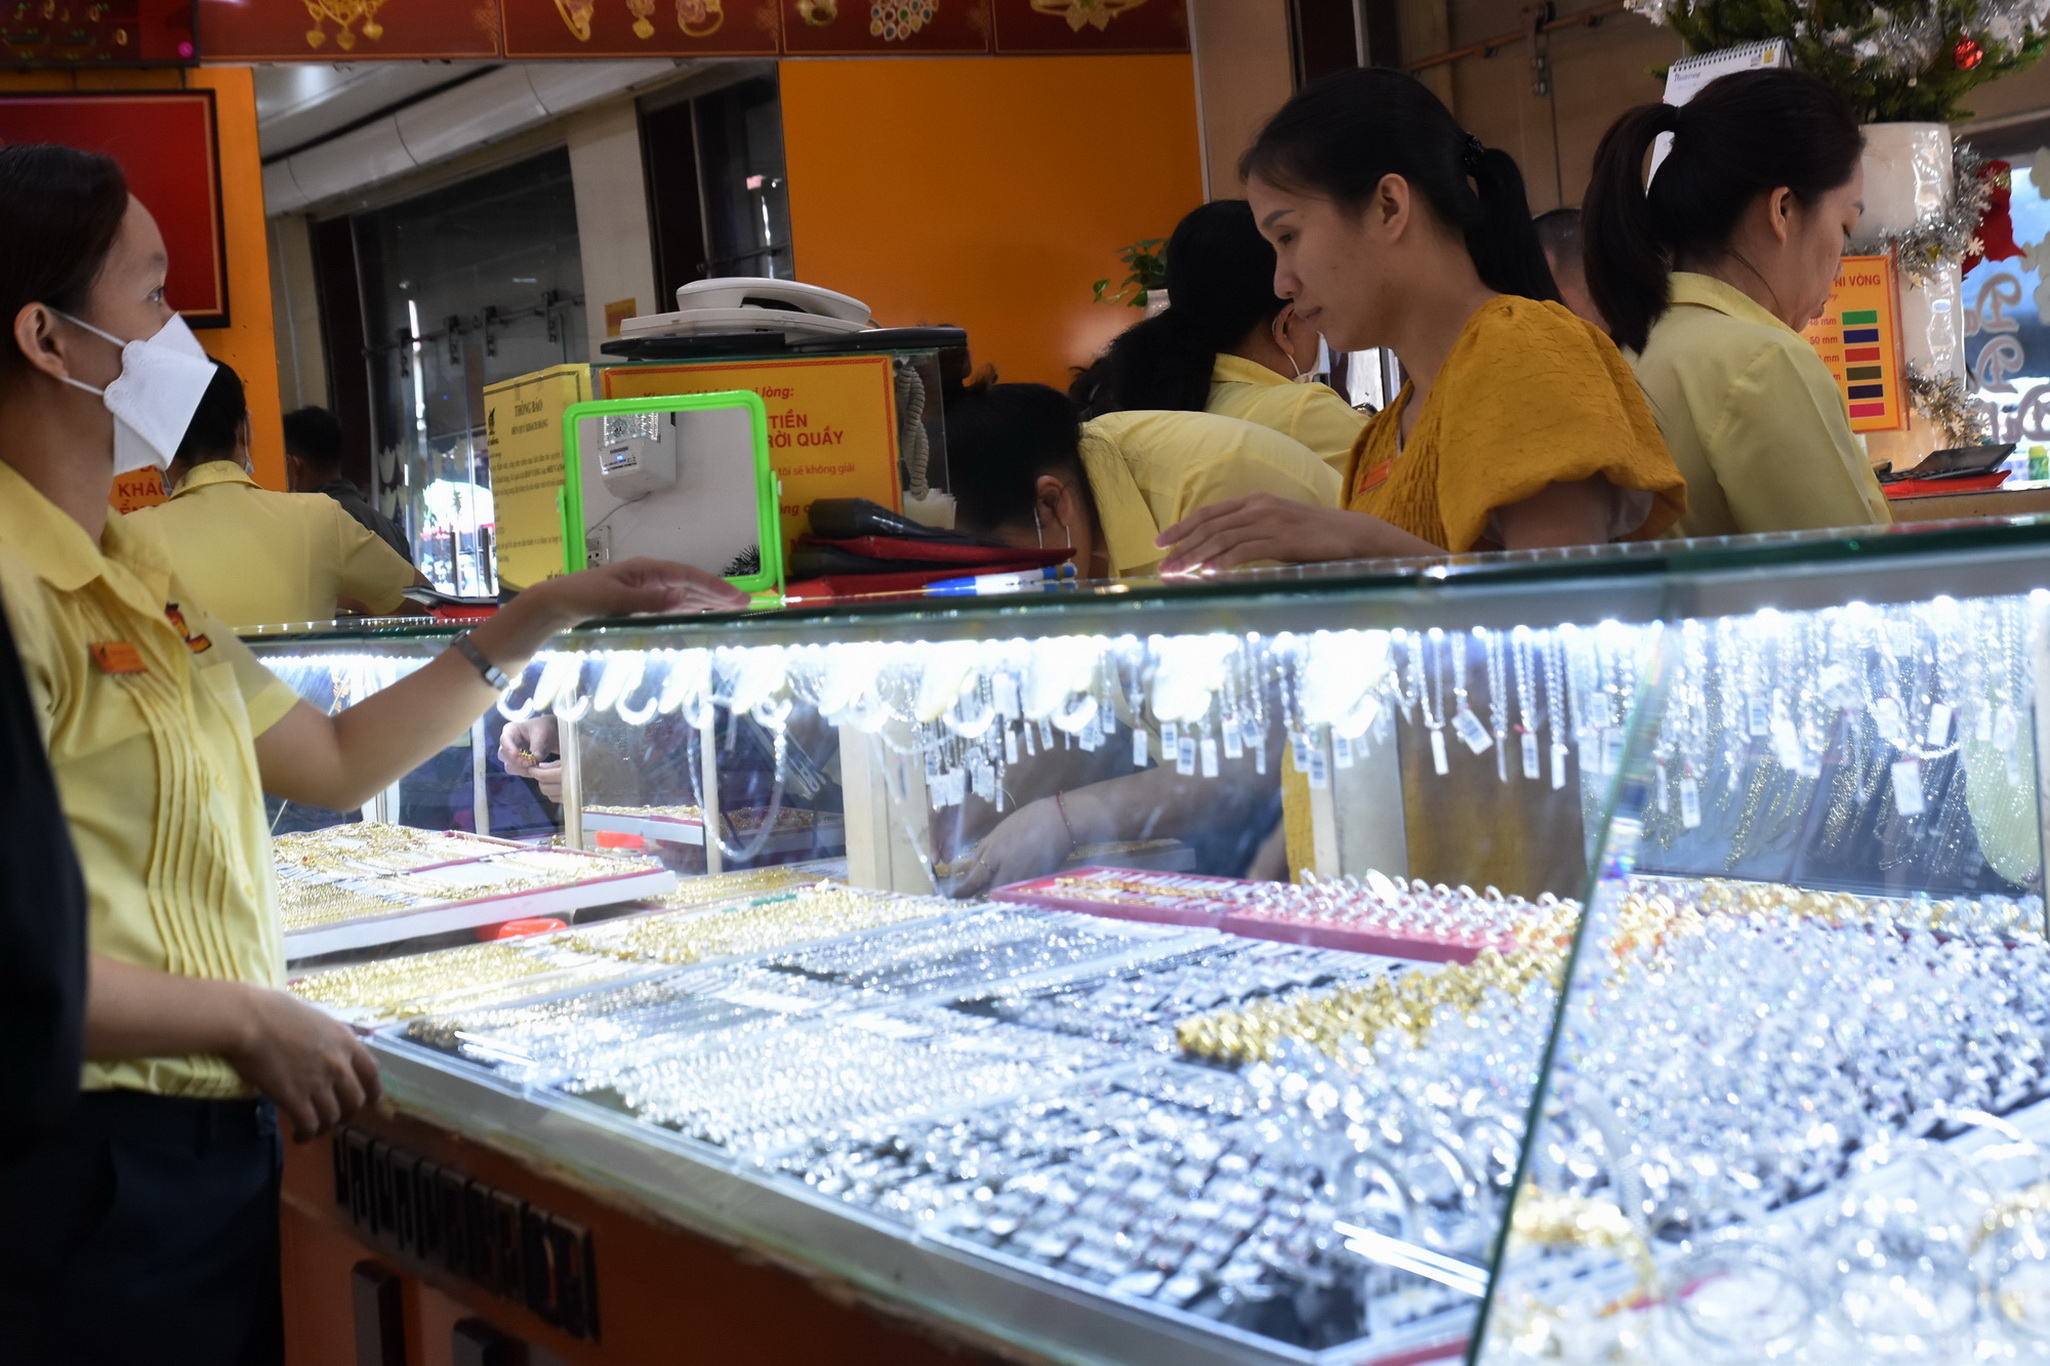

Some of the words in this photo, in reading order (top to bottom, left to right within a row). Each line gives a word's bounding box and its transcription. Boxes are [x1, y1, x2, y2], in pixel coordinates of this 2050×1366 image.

[1849, 272, 1881, 287] VÒNG
[1810, 336, 1820, 345] 50
[1822, 336, 1838, 344] mm
[1824, 355, 1840, 363] mm
[761, 387, 794, 400] lòng:
[768, 409, 808, 429] TIỀN
[797, 425, 844, 447] QUẦY
[778, 466, 791, 476] tôi
[805, 464, 836, 476] không
